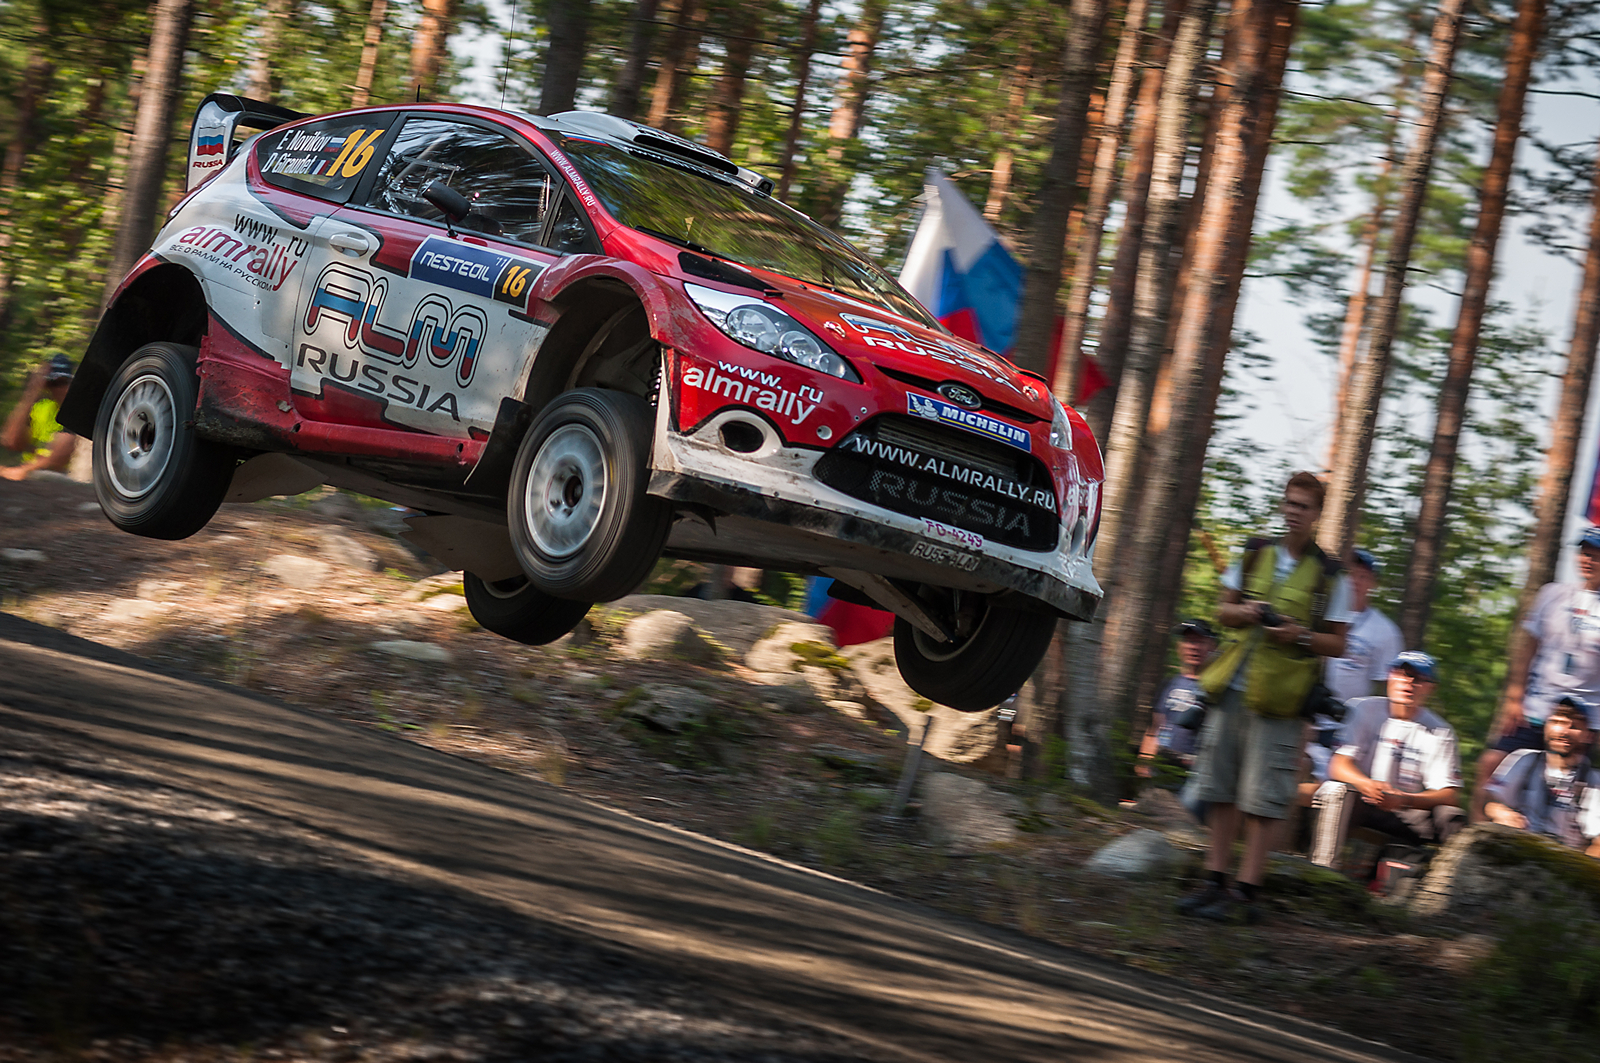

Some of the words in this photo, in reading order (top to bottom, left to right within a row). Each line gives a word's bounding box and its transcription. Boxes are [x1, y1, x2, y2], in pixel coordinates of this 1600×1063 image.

[261, 153, 278, 173] D
[271, 153, 318, 174] Giraudet
[276, 130, 294, 150] E
[286, 130, 332, 152] Novikov
[325, 129, 385, 178] 16
[550, 149, 596, 207] WWW.ALMRALLY.RU
[179, 226, 298, 292] almrally
[234, 214, 279, 247] www.
[286, 235, 309, 258] ru
[191, 249, 219, 264] РАЛЛИ
[219, 261, 234, 271] НА
[233, 267, 273, 292] РУССКОМ
[501, 265, 532, 298] 16
[303, 261, 488, 389] ALM
[297, 343, 461, 422] RUSSIA
[718, 360, 782, 390] www.
[798, 384, 824, 404] ru
[862, 336, 1023, 395] RUSSIA
[683, 367, 816, 425] almrally
[948, 387, 973, 405] Ford
[941, 406, 1026, 443] MICHELIN
[855, 437, 1056, 511] WWW.ALMRALLY.RU
[869, 470, 1031, 537] RUSSIA
